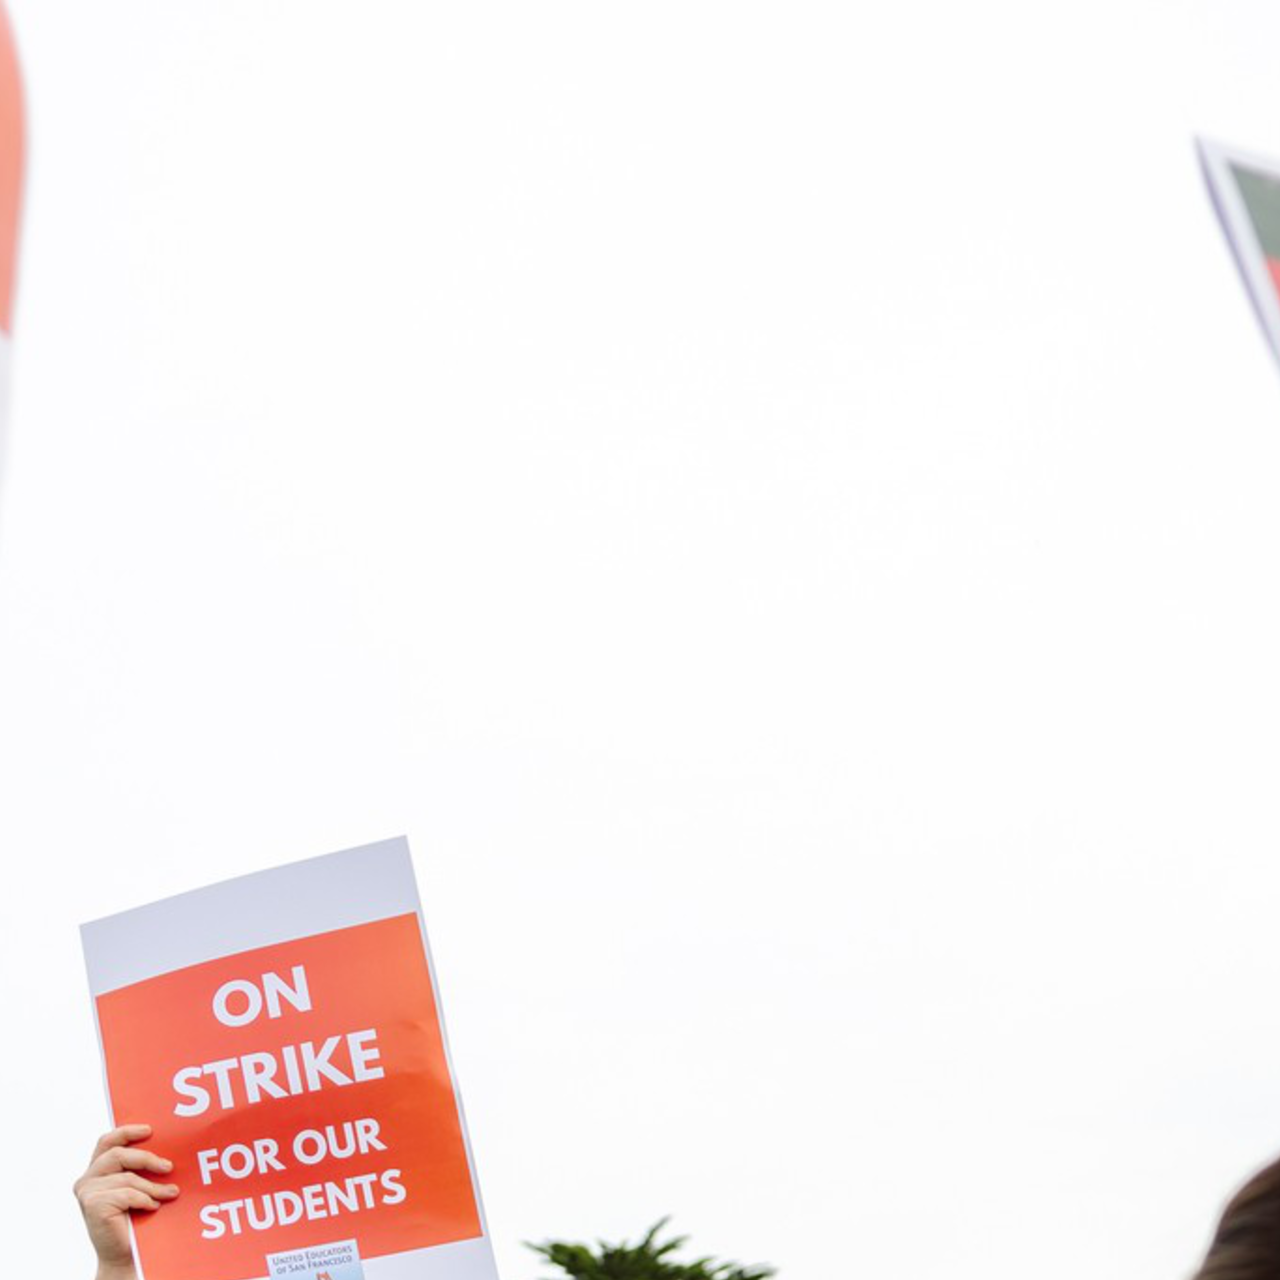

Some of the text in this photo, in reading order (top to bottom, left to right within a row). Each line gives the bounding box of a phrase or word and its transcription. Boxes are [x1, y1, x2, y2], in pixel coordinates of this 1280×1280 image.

[212, 964, 312, 1027] ON
[172, 1028, 385, 1117] STRIKE
[197, 1117, 387, 1185] FOR OUR
[199, 1168, 407, 1240] STUDENTS
